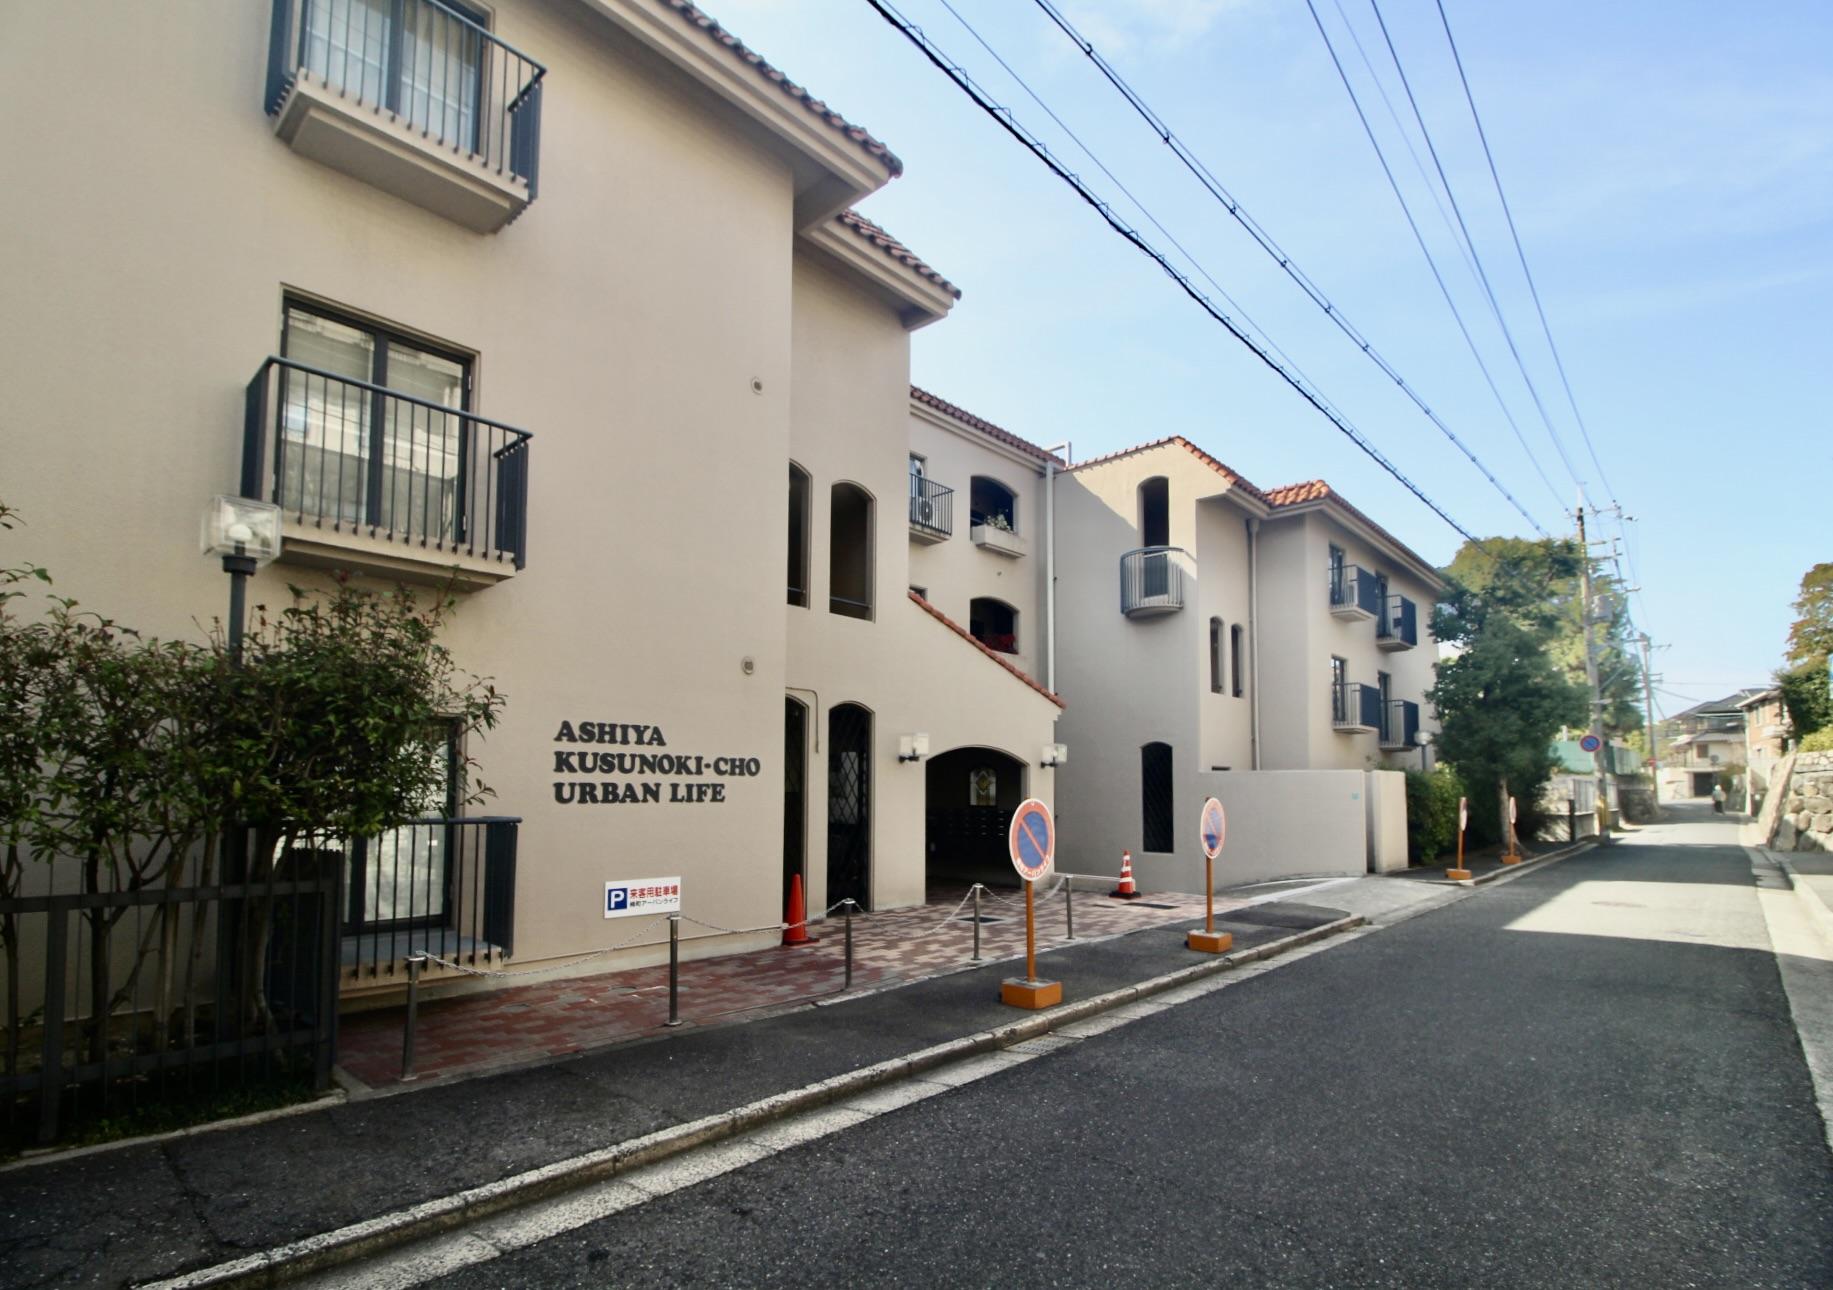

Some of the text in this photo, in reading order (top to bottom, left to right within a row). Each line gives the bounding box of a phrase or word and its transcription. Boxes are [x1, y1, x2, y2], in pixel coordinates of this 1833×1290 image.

[554, 720, 666, 746] ASHIYA
[553, 782, 726, 804] URBAN LIFE
[610, 890, 625, 909] P
[629, 885, 678, 899] 来客用駐車場
